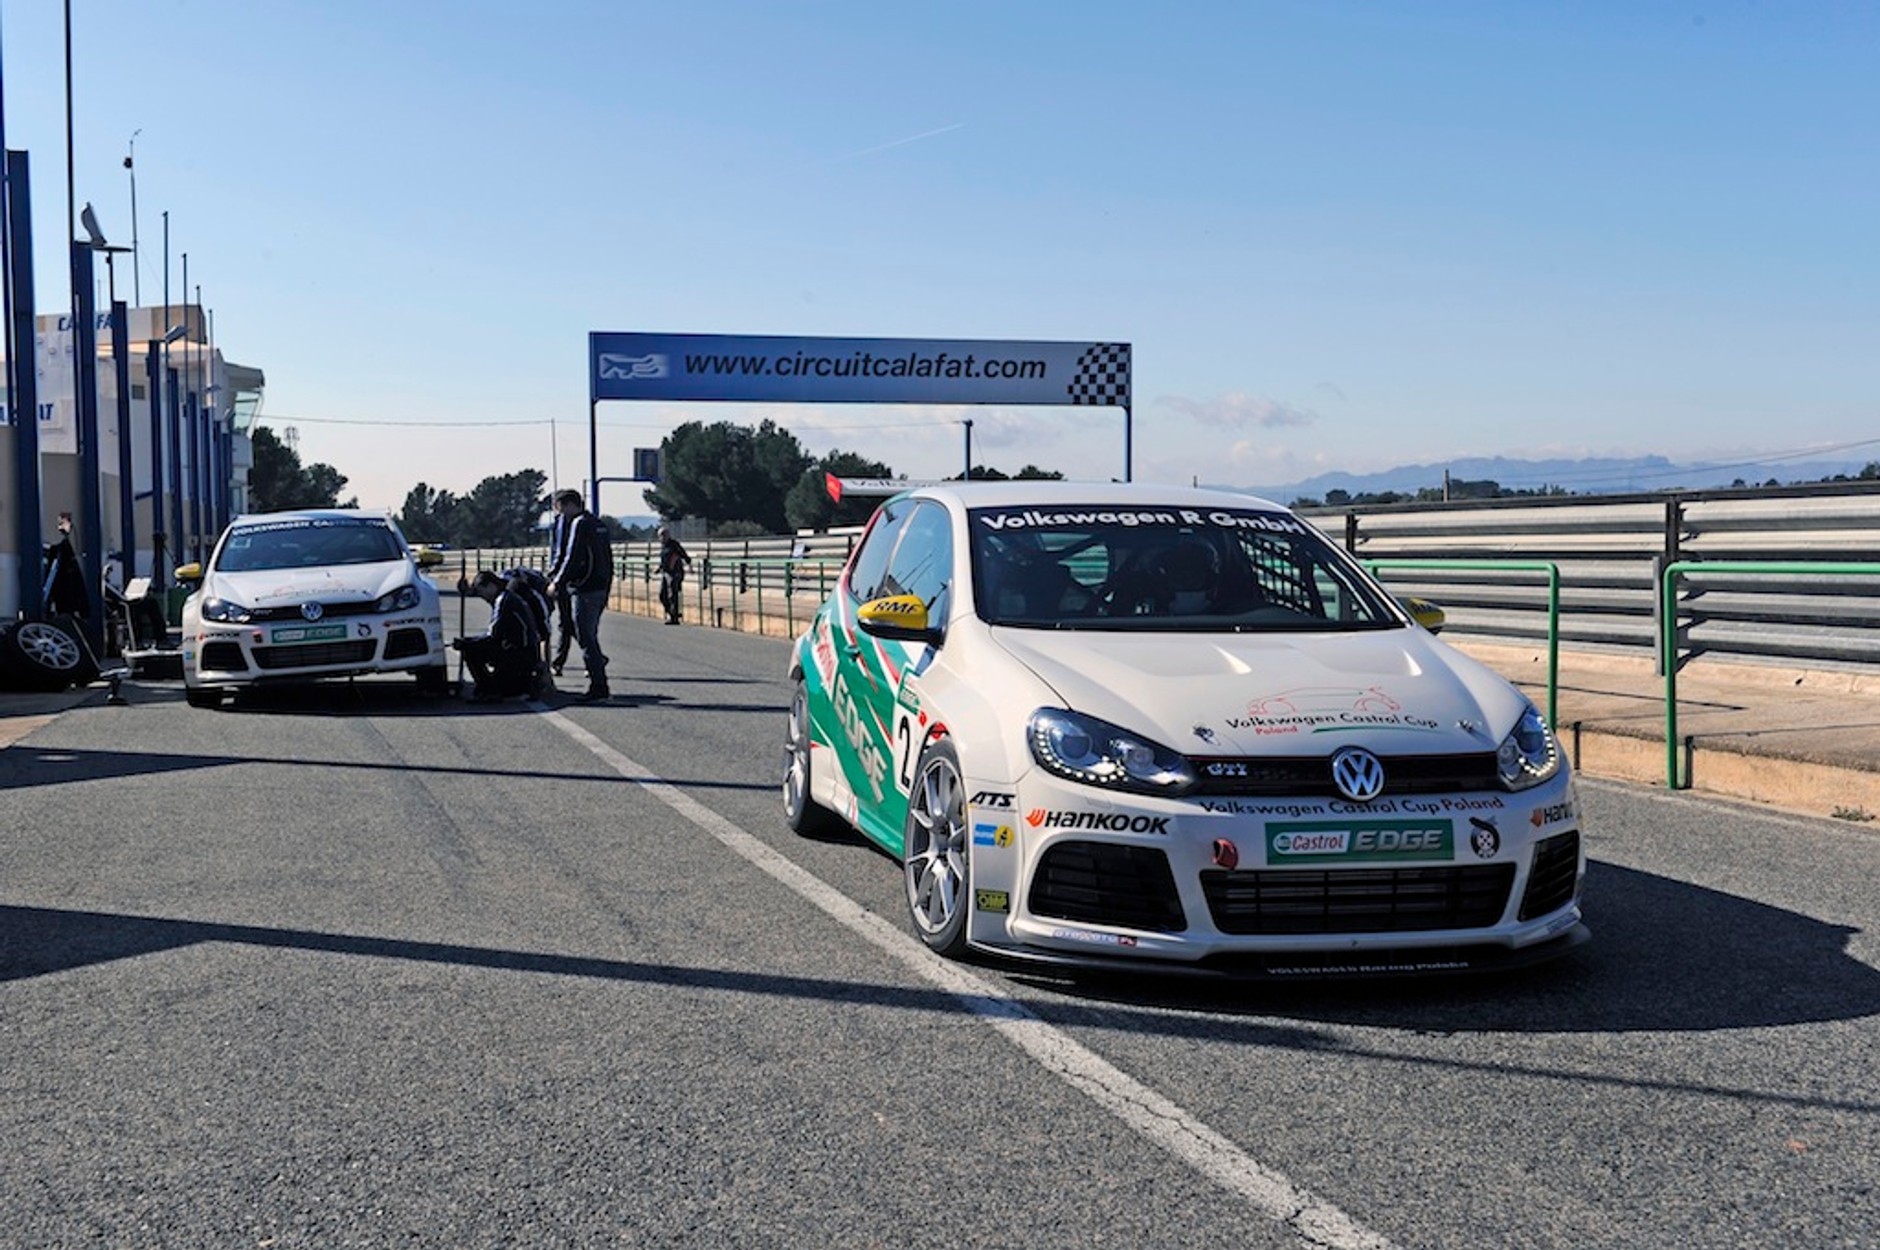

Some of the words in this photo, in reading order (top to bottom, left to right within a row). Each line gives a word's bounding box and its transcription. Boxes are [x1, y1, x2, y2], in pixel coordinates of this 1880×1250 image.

[685, 352, 1046, 379] www.circuitcalafat.com
[981, 510, 1174, 530] Volkswagen
[1178, 510, 1203, 526] R
[1209, 511, 1306, 536] GmbH
[873, 601, 920, 613] RMF
[1226, 714, 1336, 729] Volkswagen
[1340, 713, 1400, 725] Castrol
[1404, 715, 1438, 728] Cup
[834, 673, 888, 803] EDGE
[899, 715, 911, 787] 2
[970, 791, 1015, 807] ATS
[1200, 801, 1324, 816] Volkswagen
[1329, 799, 1398, 814] Castrol
[1402, 800, 1440, 814] Cup
[1442, 797, 1505, 810] Poland
[1292, 834, 1344, 850] Castrol
[1355, 829, 1443, 851] EDGE
